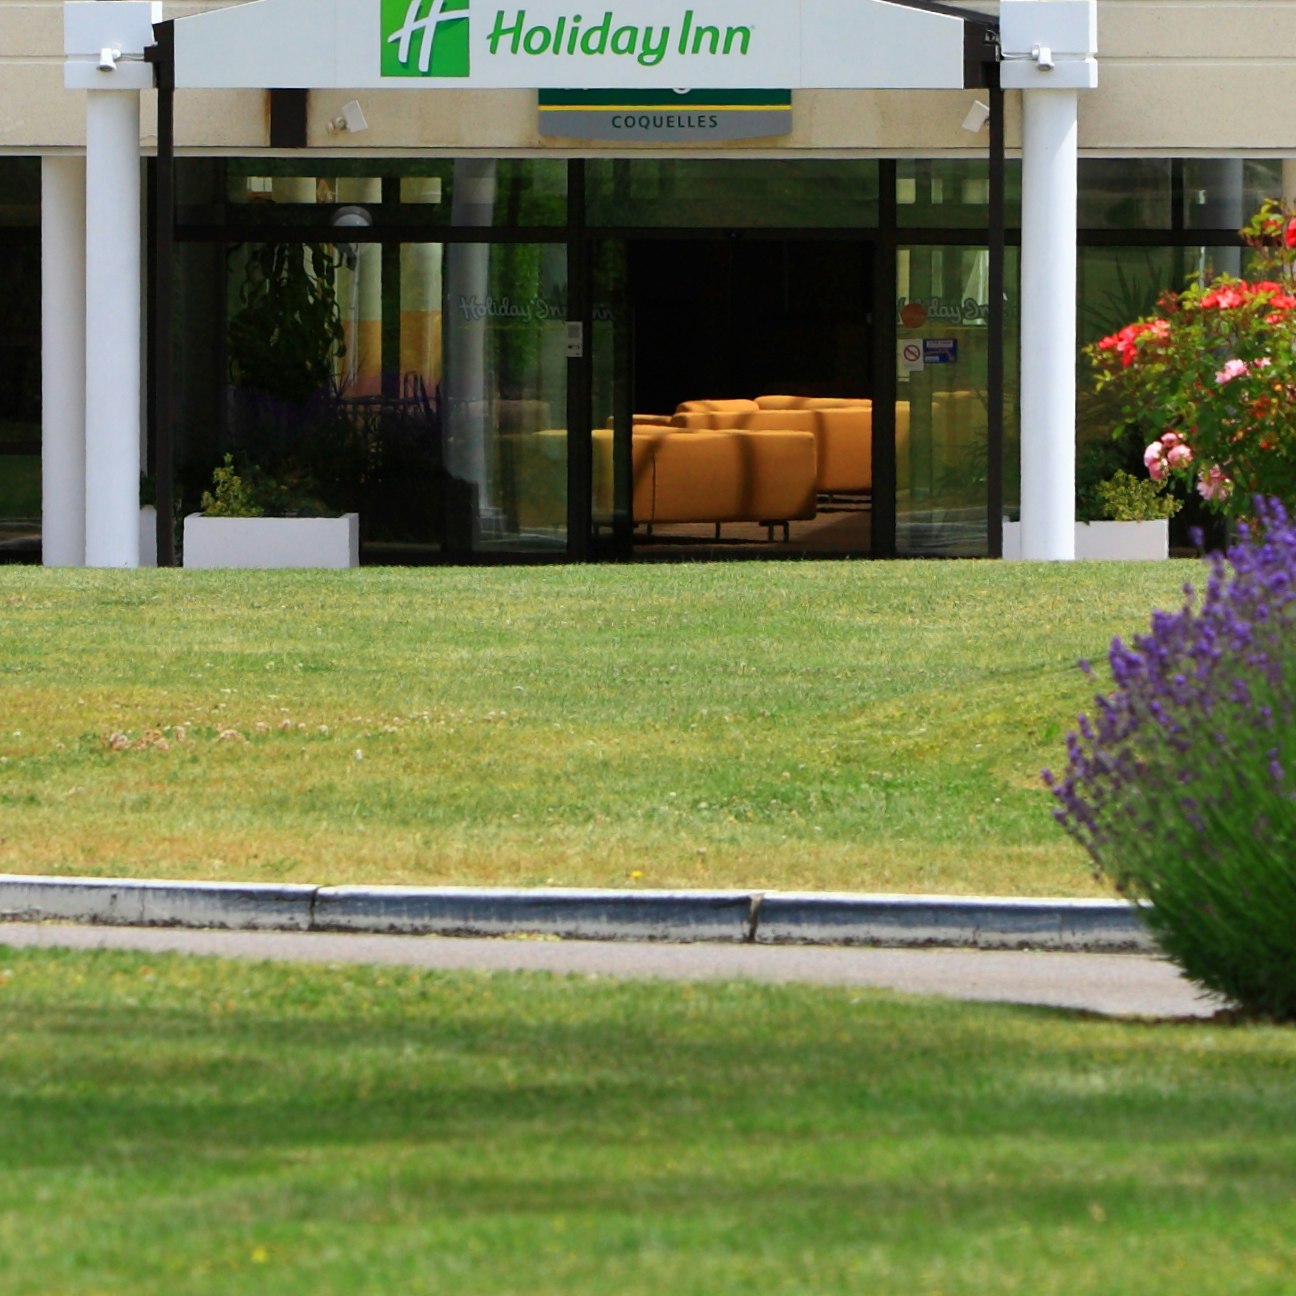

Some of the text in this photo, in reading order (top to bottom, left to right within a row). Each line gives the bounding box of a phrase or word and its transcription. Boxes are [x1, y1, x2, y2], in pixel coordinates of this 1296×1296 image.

[486, 10, 751, 66] Holiday Inn
[611, 115, 718, 131] COQUELLES
[459, 296, 533, 323] Holiday
